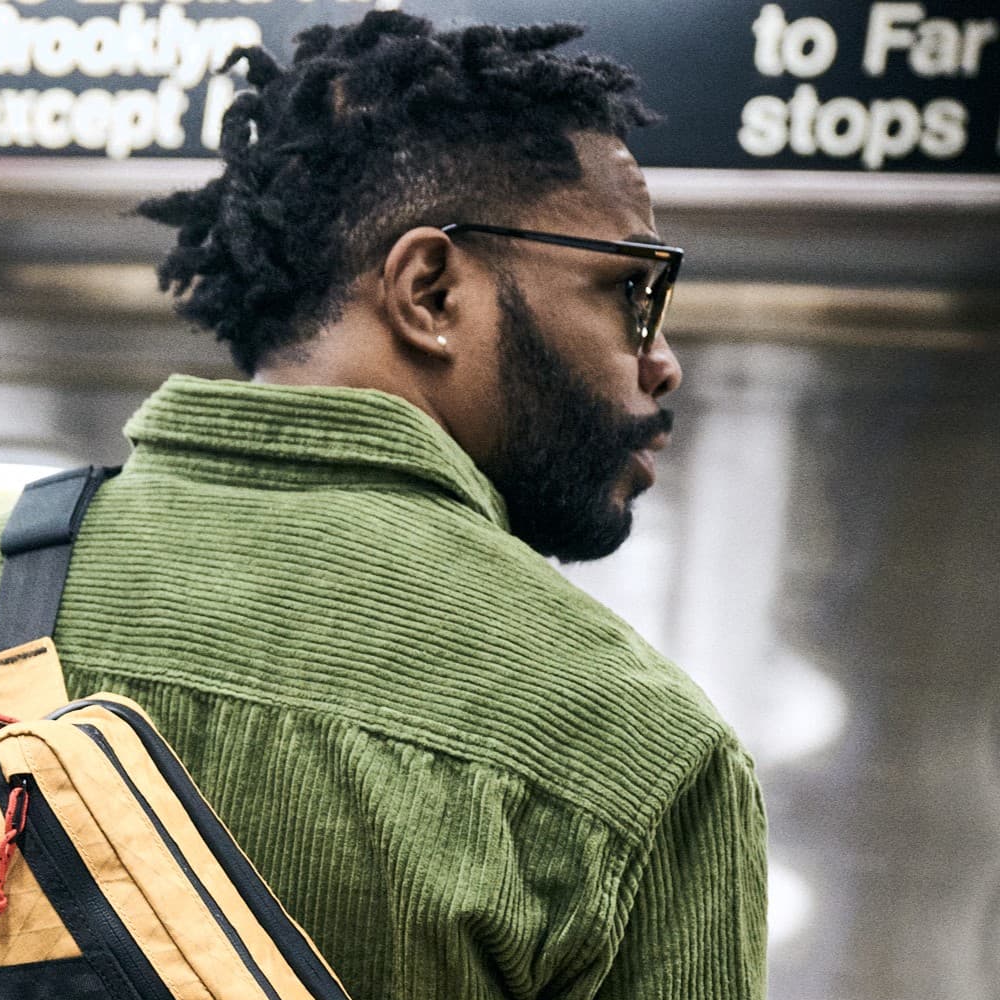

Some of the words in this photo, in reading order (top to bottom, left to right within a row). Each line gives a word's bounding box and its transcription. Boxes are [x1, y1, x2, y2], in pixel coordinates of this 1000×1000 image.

[752, 2, 838, 77] to
[862, 1, 998, 77] Far
[737, 83, 967, 170] stops
